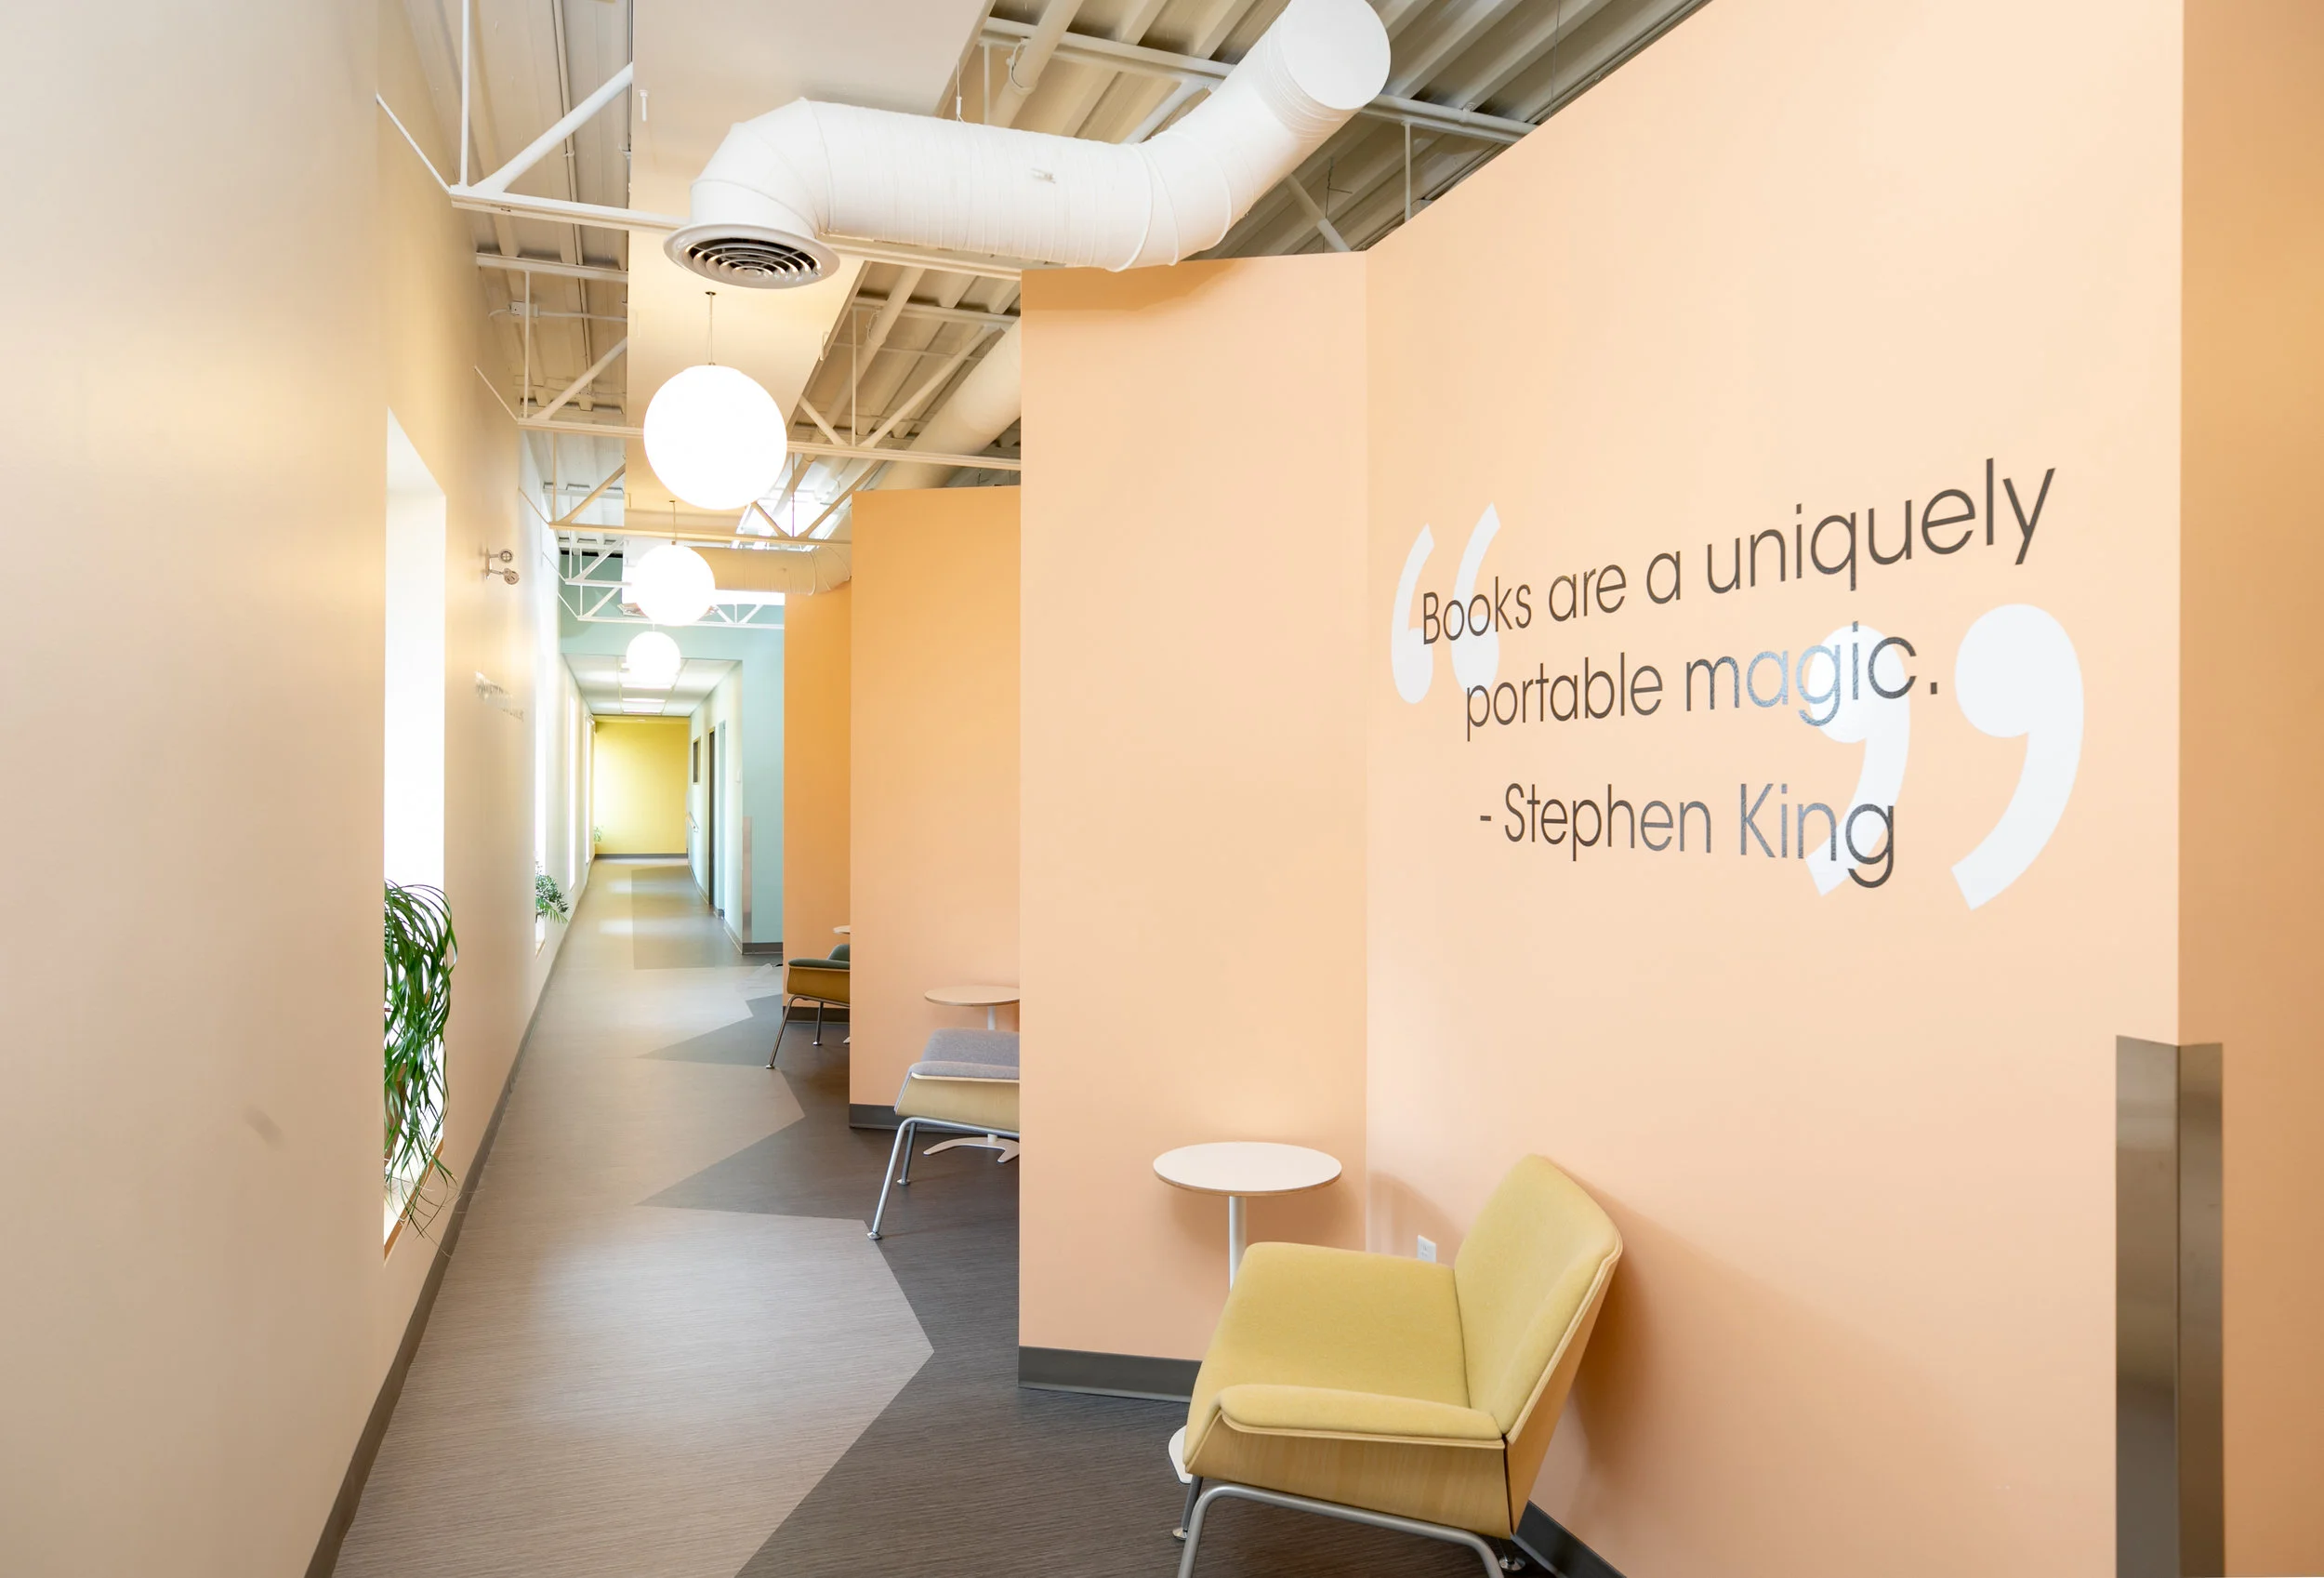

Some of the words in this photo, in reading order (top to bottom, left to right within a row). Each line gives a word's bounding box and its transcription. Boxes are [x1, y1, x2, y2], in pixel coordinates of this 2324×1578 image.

[1422, 576, 1532, 645] Books
[1548, 564, 1627, 623] are
[1645, 550, 1682, 605] a
[1707, 457, 2056, 594] uniquely
[1466, 651, 1663, 743] portable
[1685, 620, 1938, 727] magic.
[1740, 783, 1895, 889] King
